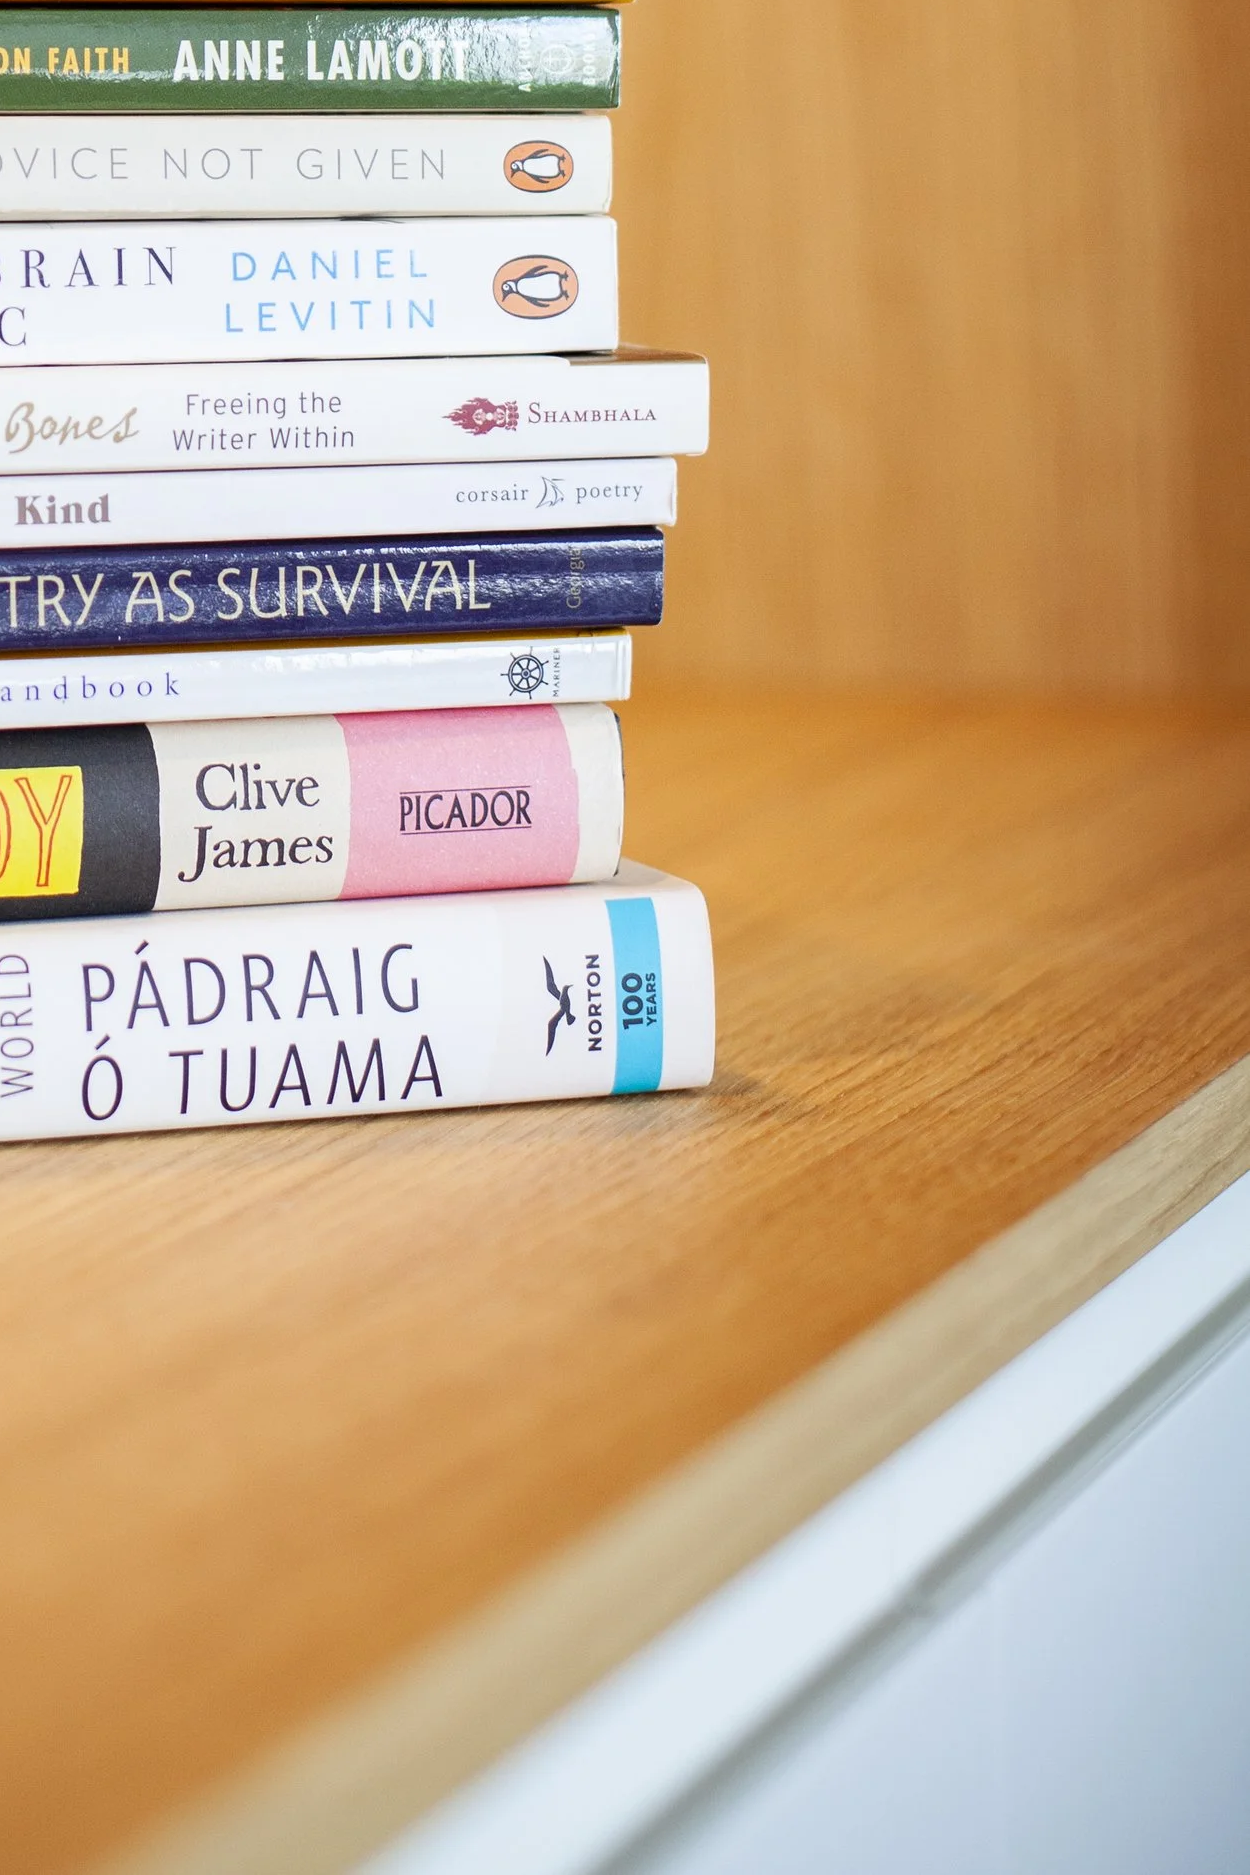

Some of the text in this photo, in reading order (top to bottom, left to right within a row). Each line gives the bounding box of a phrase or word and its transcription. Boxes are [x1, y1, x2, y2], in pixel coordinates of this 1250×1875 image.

[48, 47, 130, 75] FAITH
[173, 39, 471, 82] ANNE LAMOTT
[163, 148, 264, 180] NOT
[296, 148, 447, 180] GIVEN
[232, 248, 429, 282] DANIEL
[226, 299, 436, 334] LEVITIN
[5, 400, 142, 455] Bones
[186, 392, 343, 418] Freeing the
[527, 401, 658, 425] SHAMBHALA
[172, 425, 355, 451] Writer Within
[14, 494, 112, 527] Kind
[455, 480, 644, 505] corsair poetry
[124, 568, 196, 624] AS
[216, 558, 492, 622] SURVIVAL
[565, 547, 585, 610] Georgia
[552, 646, 561, 698] MARINER
[194, 762, 320, 812] Clive
[399, 788, 533, 832] PICADOR
[177, 825, 334, 884] James
[81, 939, 421, 1032] PÁDRAIG
[585, 953, 602, 1053] NORTON
[621, 971, 644, 1031] 100
[645, 971, 657, 1027] YEARS
[81, 1034, 444, 1122] Ó TUAMA
